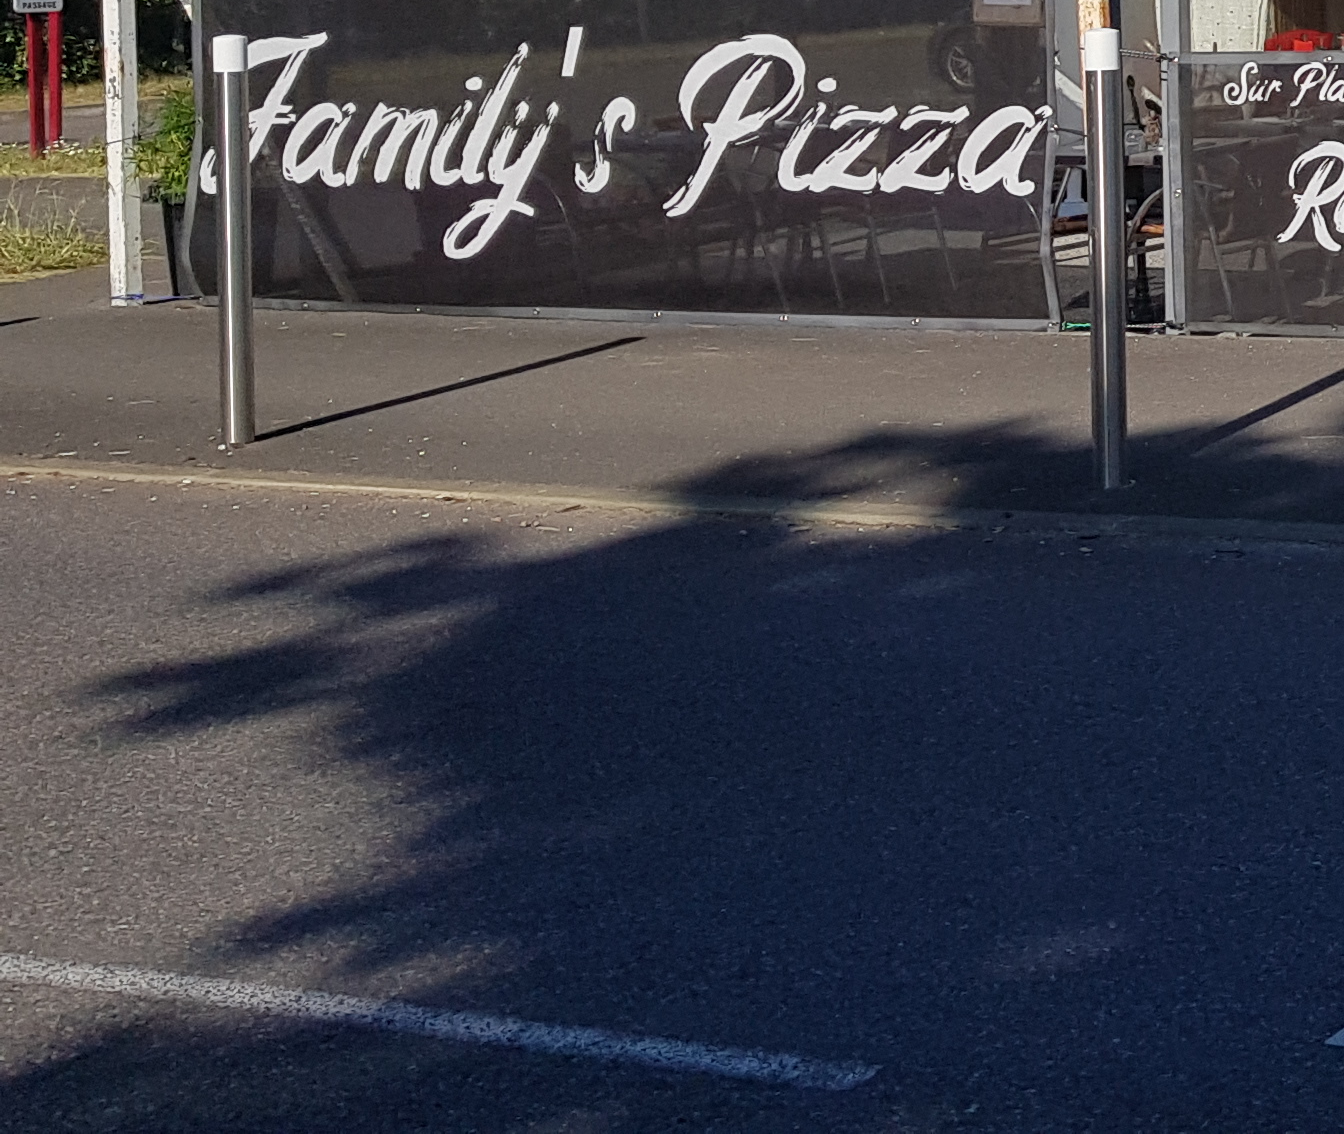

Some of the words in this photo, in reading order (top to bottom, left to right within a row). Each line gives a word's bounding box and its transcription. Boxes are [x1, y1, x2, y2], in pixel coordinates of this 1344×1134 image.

[200, 26, 636, 260] Family's
[662, 33, 1054, 218] Pizza
[1223, 61, 1282, 106] Sur
